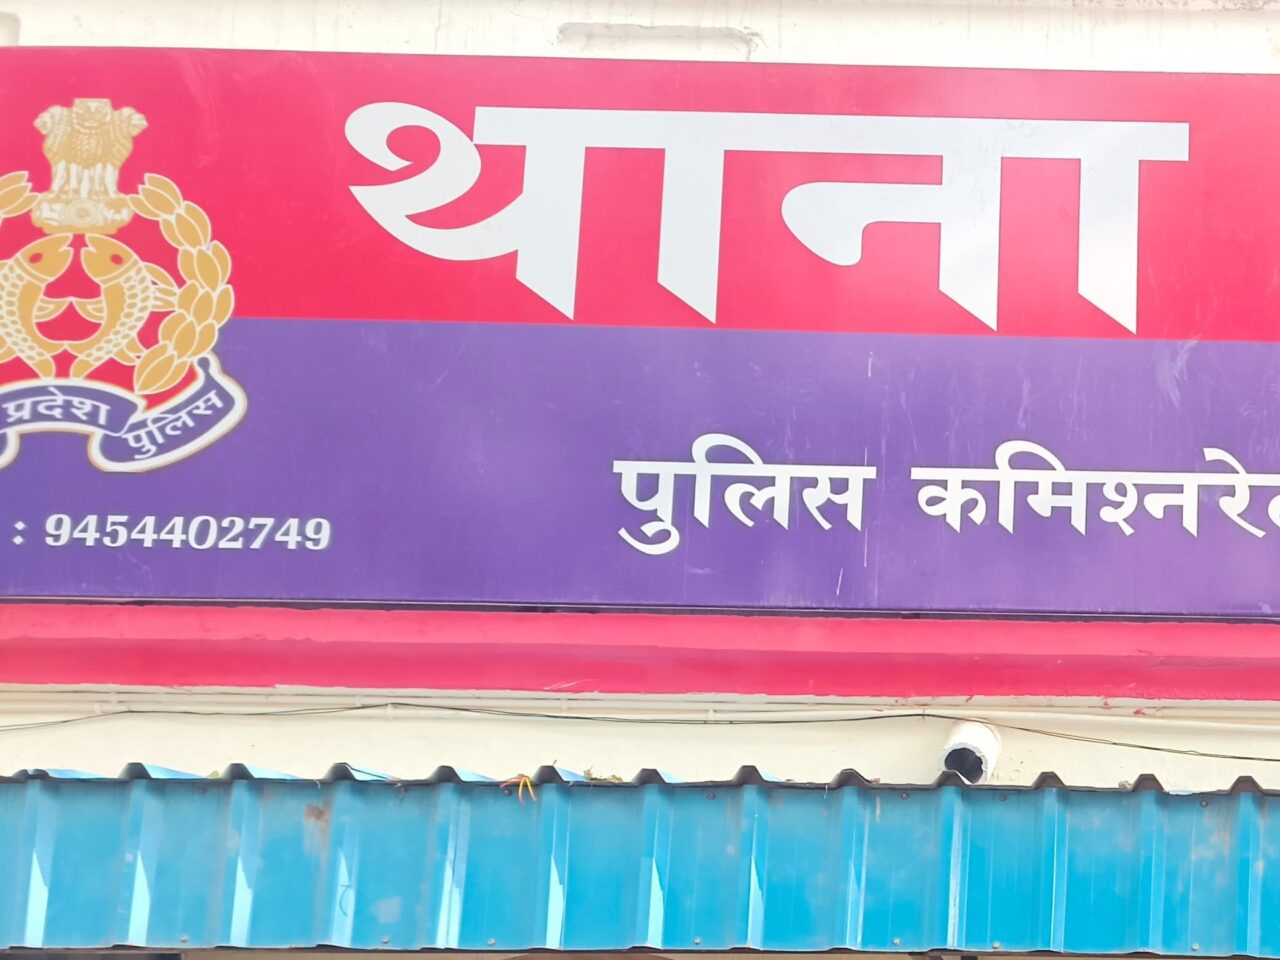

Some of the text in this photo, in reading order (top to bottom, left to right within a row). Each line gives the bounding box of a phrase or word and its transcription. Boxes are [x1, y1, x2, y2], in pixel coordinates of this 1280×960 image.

[345, 102, 1190, 332] थाना
[2, 386, 224, 460] प्रदेश पुलिस
[44, 513, 331, 551] 9454402749
[612, 433, 878, 556] पुलिस
